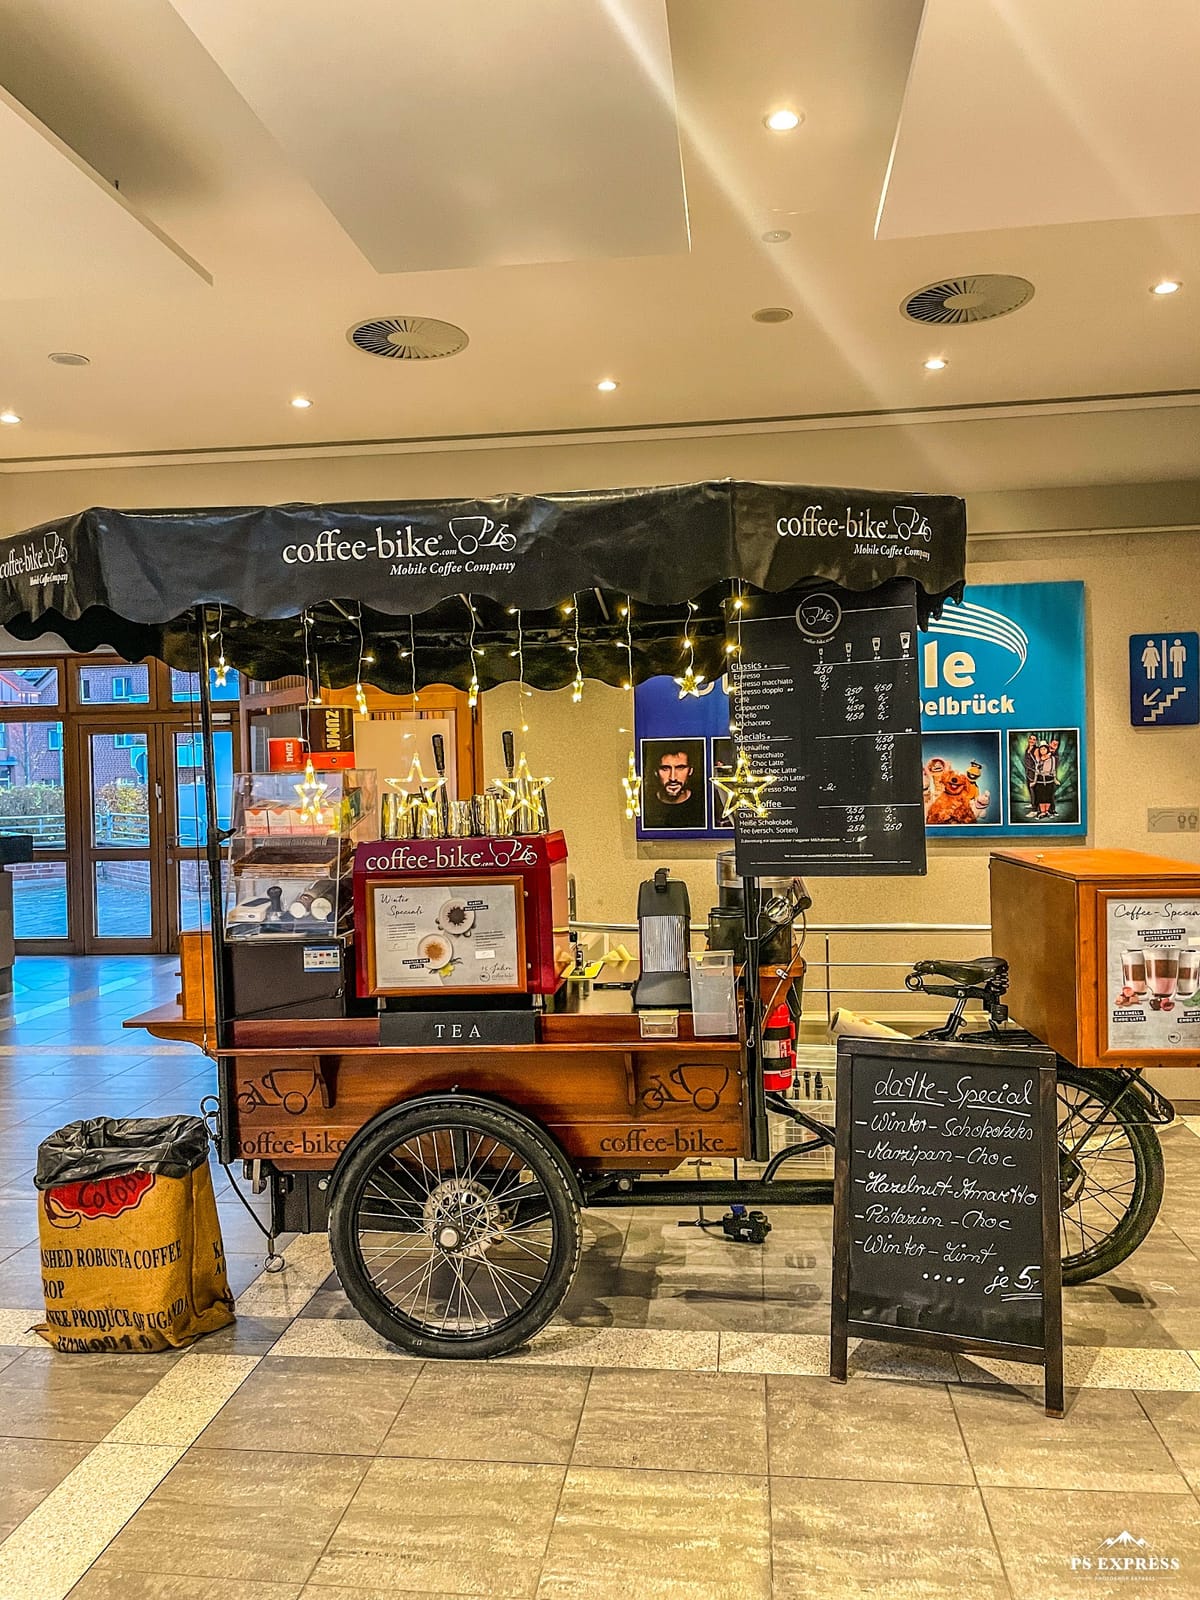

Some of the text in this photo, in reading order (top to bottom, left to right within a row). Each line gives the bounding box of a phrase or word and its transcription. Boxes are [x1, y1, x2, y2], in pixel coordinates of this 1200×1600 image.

[776, 505, 887, 540] coffee-bike
[282, 524, 440, 564] coffee-bike
[853, 543, 880, 555] Mobile
[880, 544, 902, 558] Coffee
[390, 560, 516, 577] Mobile Coffee Company
[920, 693, 1015, 716] elbrück
[734, 732, 766, 741] Specials
[755, 787, 782, 795] presso
[782, 785, 797, 793] Shot
[366, 845, 482, 871] coffee-bike
[434, 1024, 482, 1038] TEA
[239, 1131, 347, 1154] offee-bike
[600, 1128, 725, 1152] coffee-bike
[76, 1247, 132, 1269] ROBUSTA
[133, 1239, 183, 1270] COFFEE
[984, 1265, 1009, 1295] je
[72, 1309, 133, 1329] PRODUCE
[133, 1312, 145, 1332] OF
[147, 1294, 189, 1330] UGANDA
